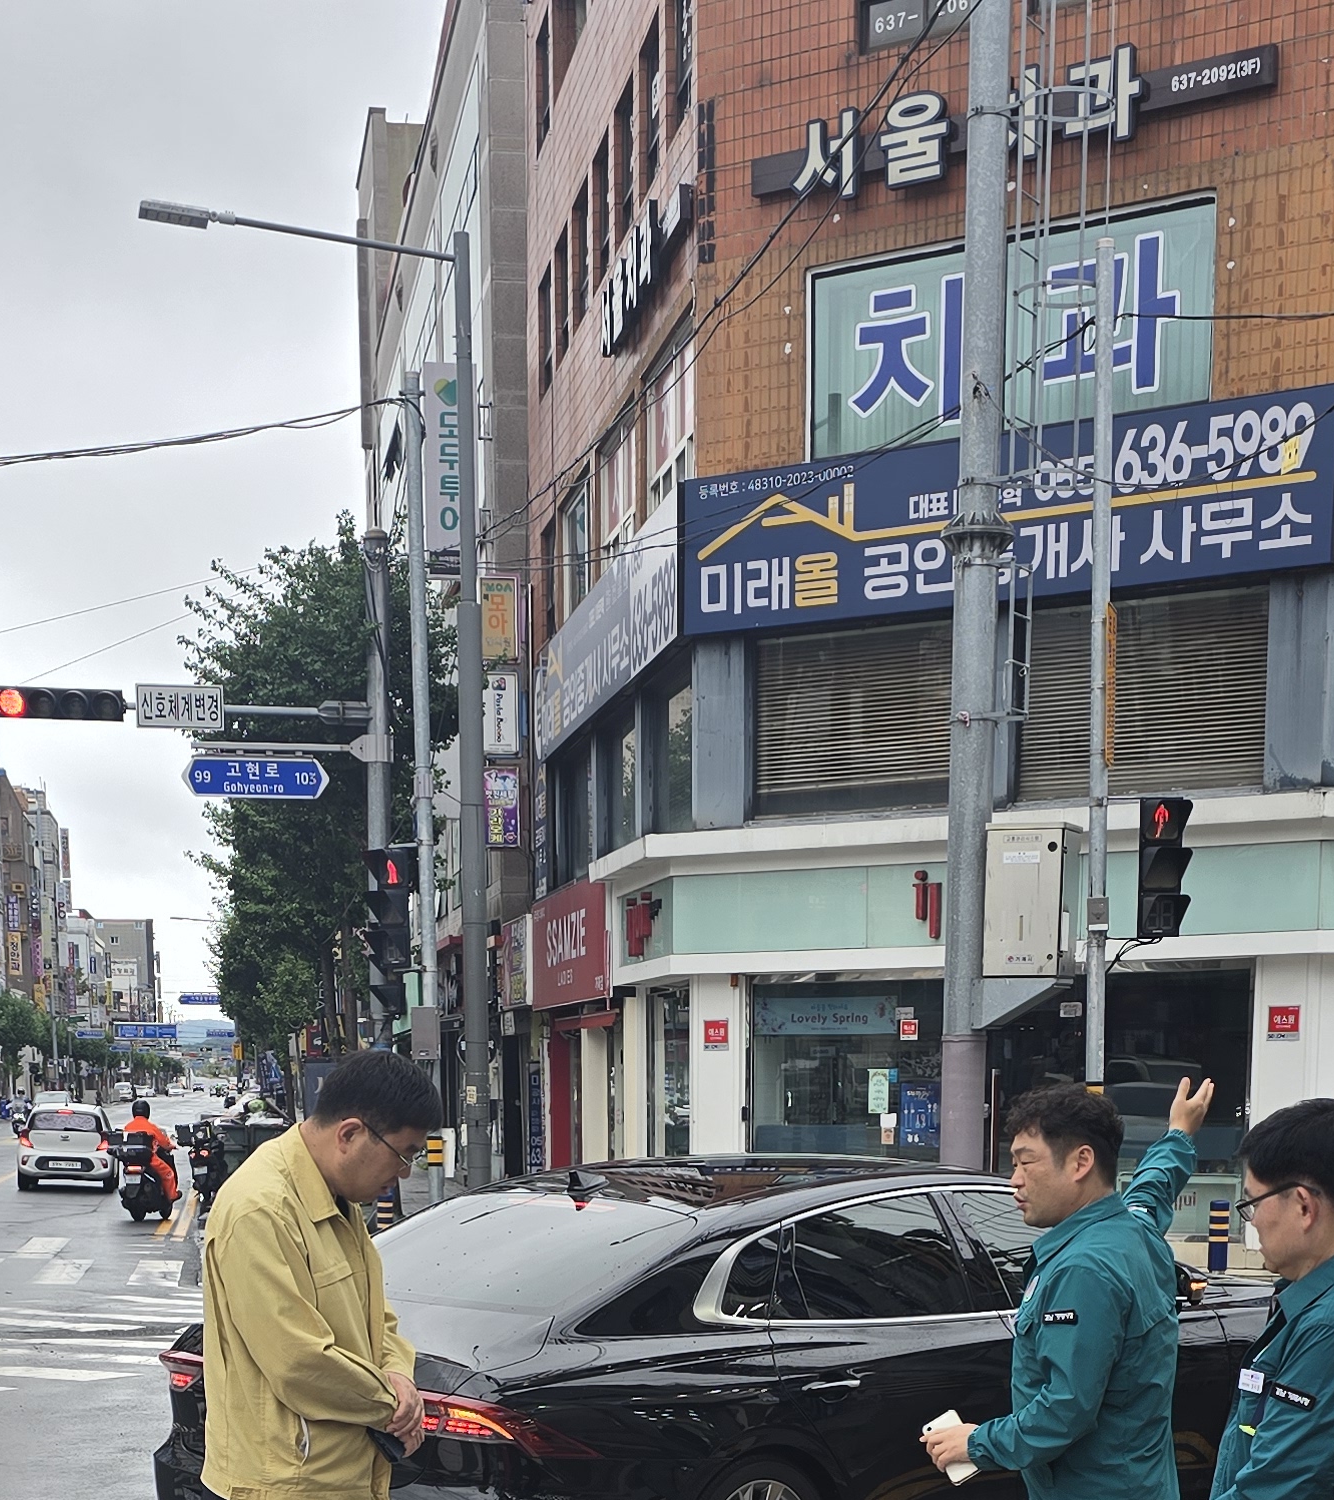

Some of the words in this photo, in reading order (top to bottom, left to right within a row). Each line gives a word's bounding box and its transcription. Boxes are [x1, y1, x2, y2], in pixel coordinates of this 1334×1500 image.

[874, 12, 919, 33] 637-
[1171, 57, 1262, 92] 637-2092(3F)
[848, 231, 1181, 428] 치과
[908, 494, 949, 518] 대표
[1114, 401, 1316, 488] 636-5989
[697, 482, 739, 500] 등록번호
[699, 549, 840, 615] 미래올
[1139, 498, 1315, 568] 사무소
[488, 594, 508, 636] 모아
[632, 552, 676, 673] 636-5989
[141, 691, 219, 724] 신호체계변경
[194, 771, 211, 783] 99
[223, 782, 284, 795] Gohyeon-ro
[295, 772, 317, 786] 103
[226, 761, 280, 780] 고현로
[489, 808, 504, 843] 가라오케
[546, 908, 586, 968] SSAMZIE
[791, 1013, 827, 1025] Lovely
[832, 1012, 869, 1025] Spring
